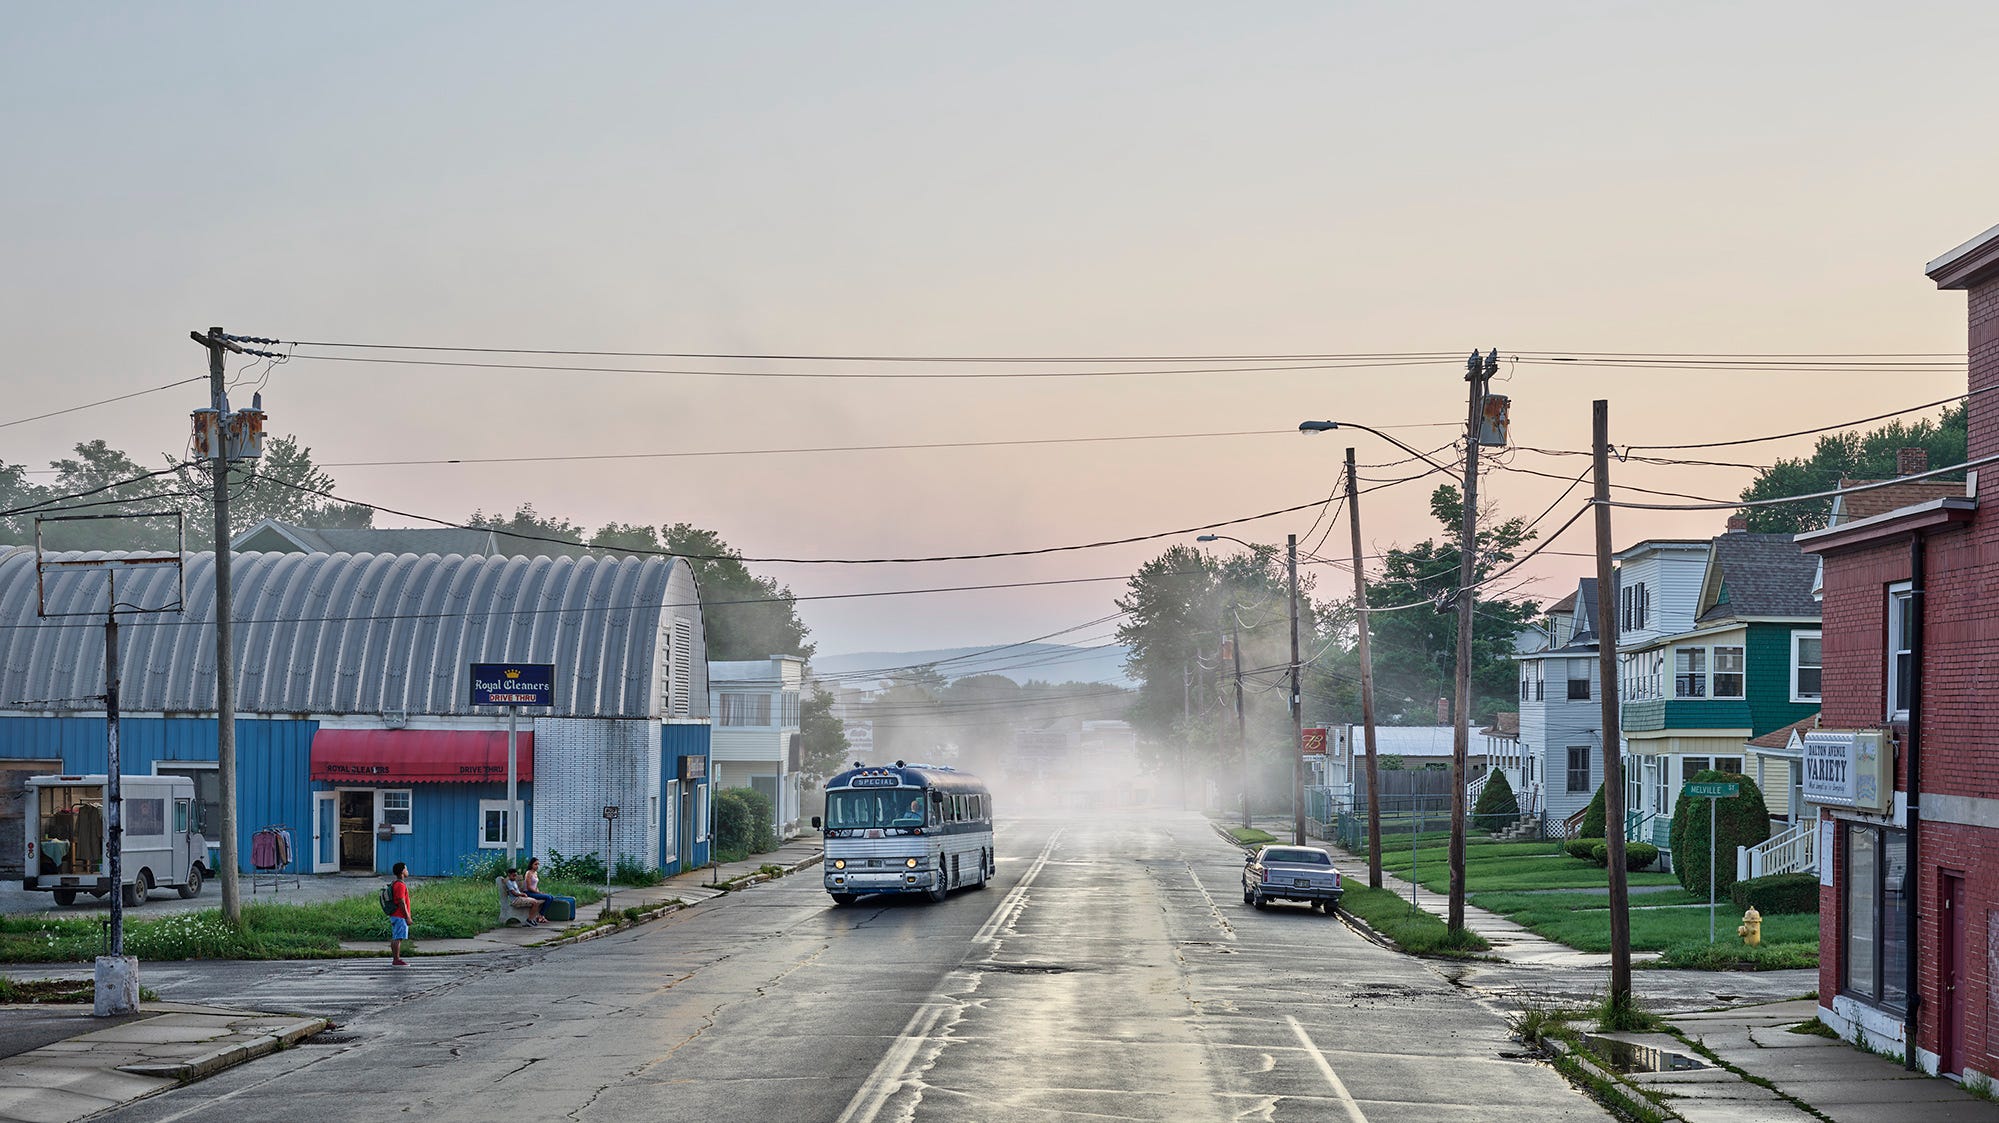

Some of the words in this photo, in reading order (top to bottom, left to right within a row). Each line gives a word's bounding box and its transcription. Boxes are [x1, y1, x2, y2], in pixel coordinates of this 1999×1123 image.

[475, 679, 502, 693] Royal
[503, 679, 550, 691] Cleaners
[489, 694, 513, 702] DRIVE
[515, 694, 537, 702] THRU
[1808, 744, 1827, 757] DALTON
[1827, 745, 1846, 758] AVENUE
[327, 764, 350, 773] ROYAL
[1806, 758, 1847, 783] VARIETY
[1690, 785, 1722, 795] MELVILLE
